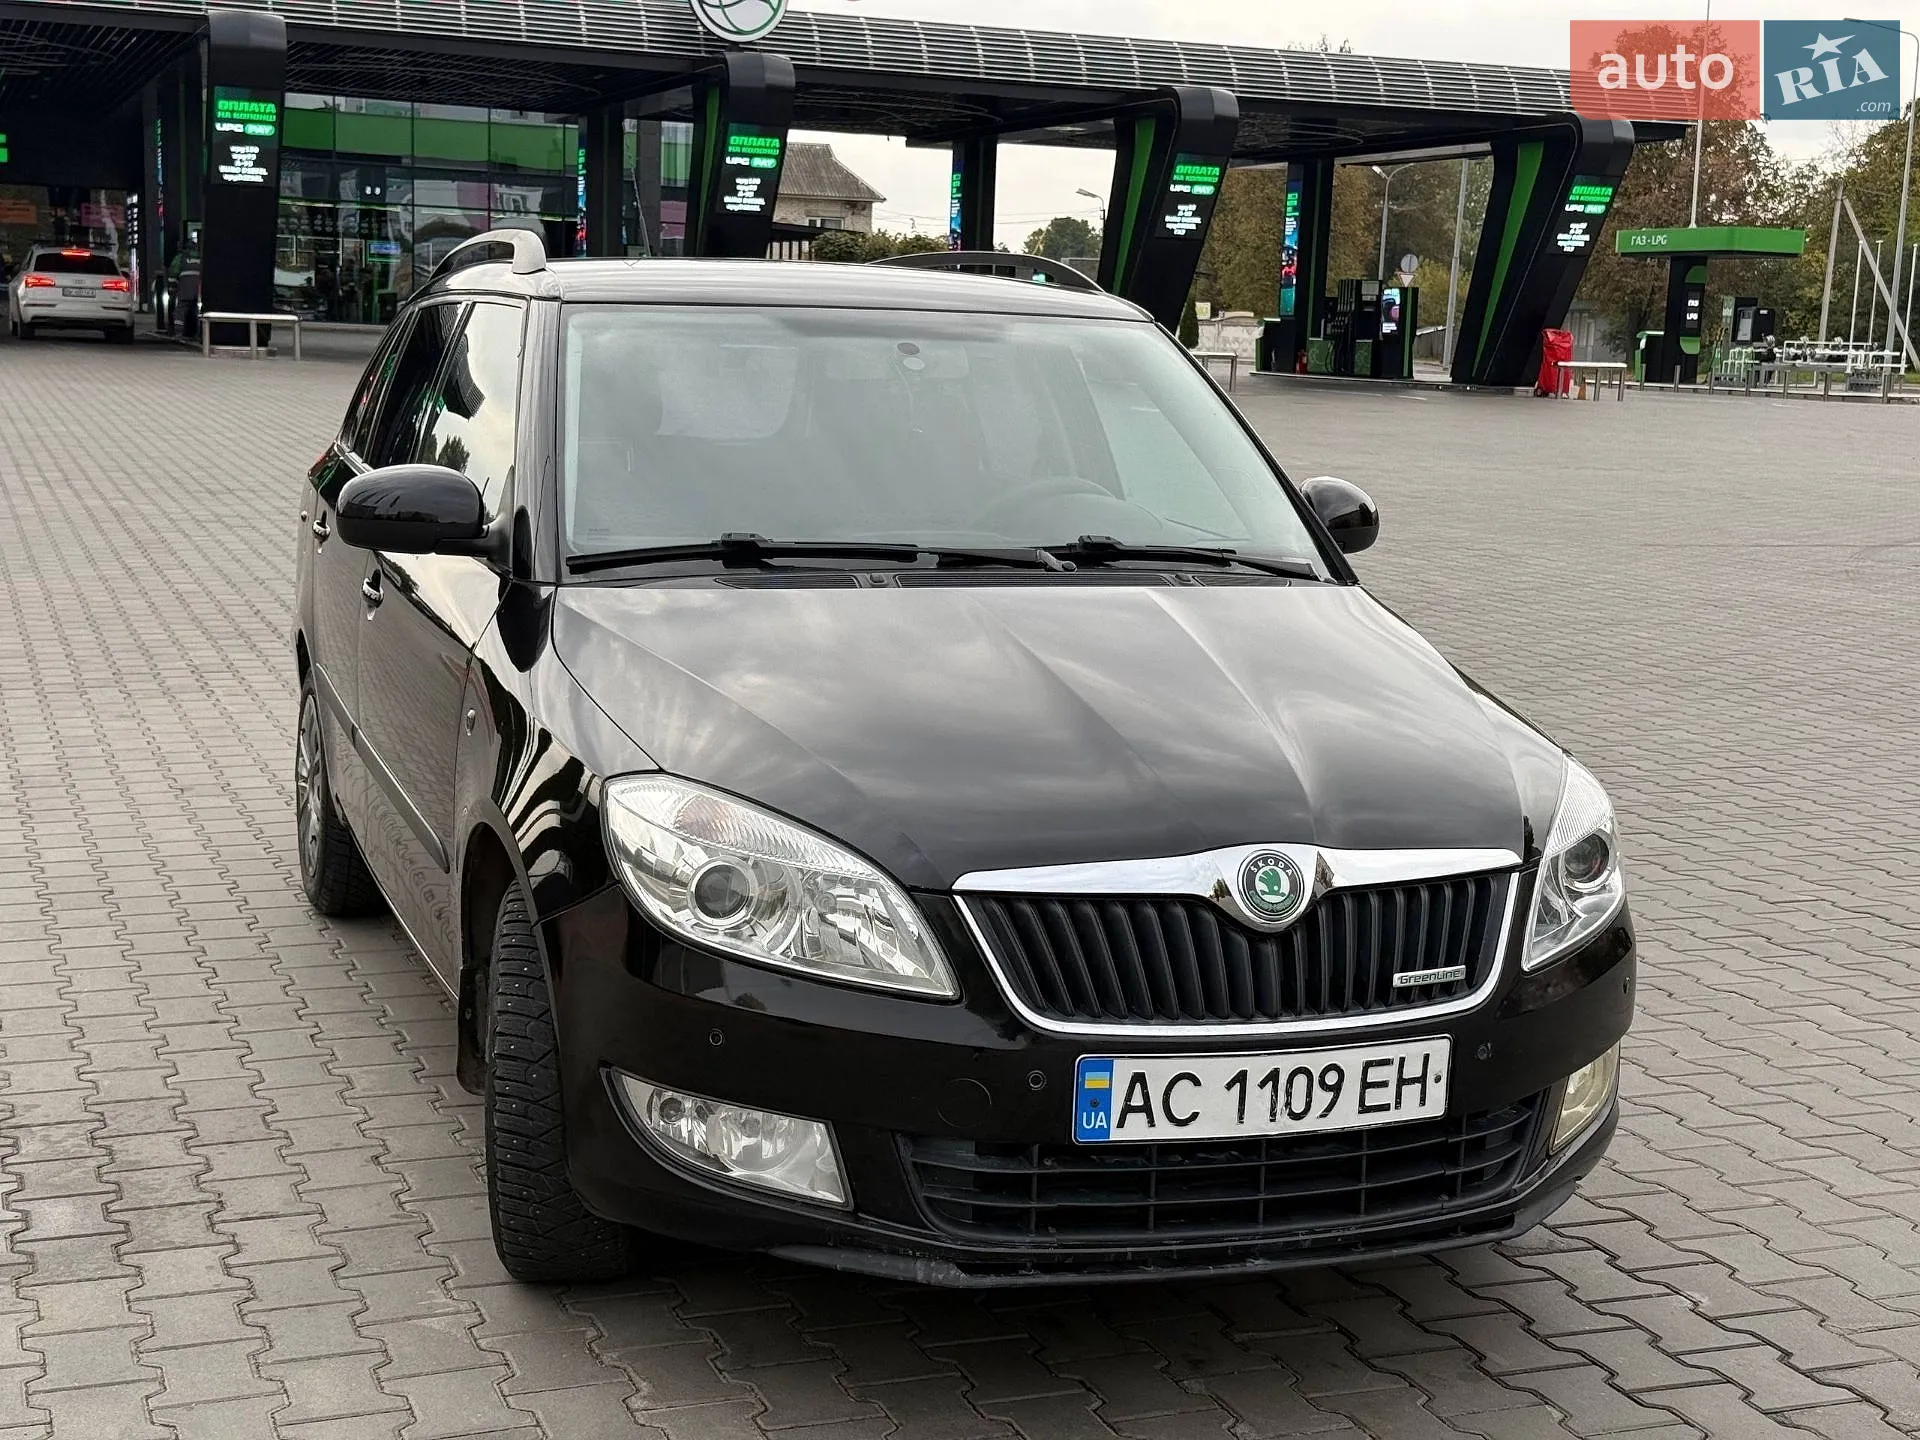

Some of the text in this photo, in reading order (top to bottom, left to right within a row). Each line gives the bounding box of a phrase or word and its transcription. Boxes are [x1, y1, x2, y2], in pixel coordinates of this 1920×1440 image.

[218, 100, 276, 113] ОПЛАТА
[730, 135, 780, 148] ОПЛАТА
[1175, 165, 1220, 176] ОПЛАТА
[1572, 185, 1613, 196] ОПЛАТА
[1400, 969, 1461, 985] GreenLine
[1116, 1052, 1431, 1129] AC 1109 EH
[1082, 1112, 1108, 1129] UA
